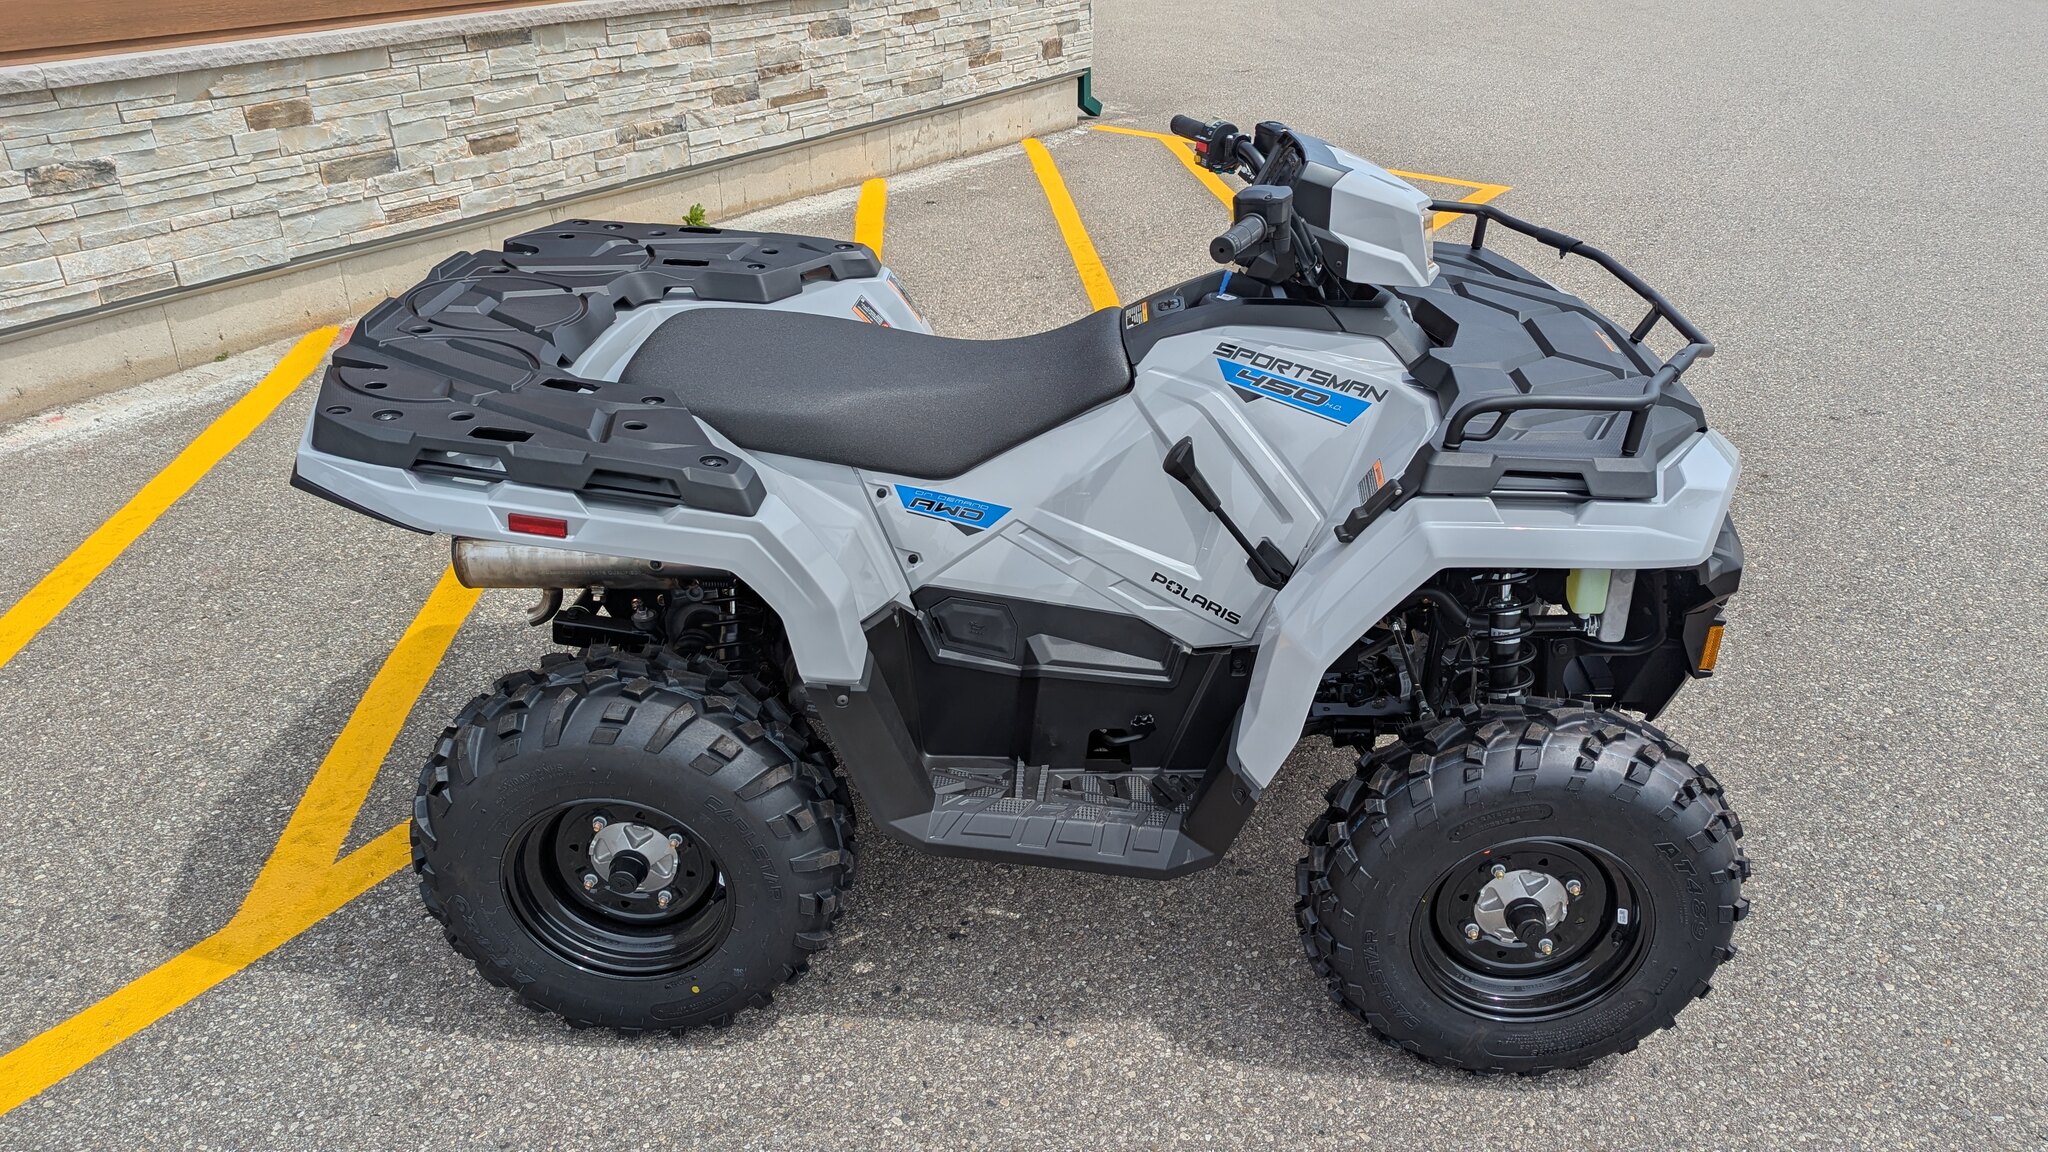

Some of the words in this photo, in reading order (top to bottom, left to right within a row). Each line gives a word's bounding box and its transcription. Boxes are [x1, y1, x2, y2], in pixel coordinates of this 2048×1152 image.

[1212, 342, 1389, 403] SPORTSMAN
[1235, 368, 1331, 407] 450
[908, 497, 986, 522] AWD
[914, 489, 933, 498] ON
[937, 495, 990, 511] DEMAND
[1150, 571, 1242, 625] POLARIS
[1652, 840, 1708, 943] AT489
[1363, 928, 1422, 1031] CARLSTAR
